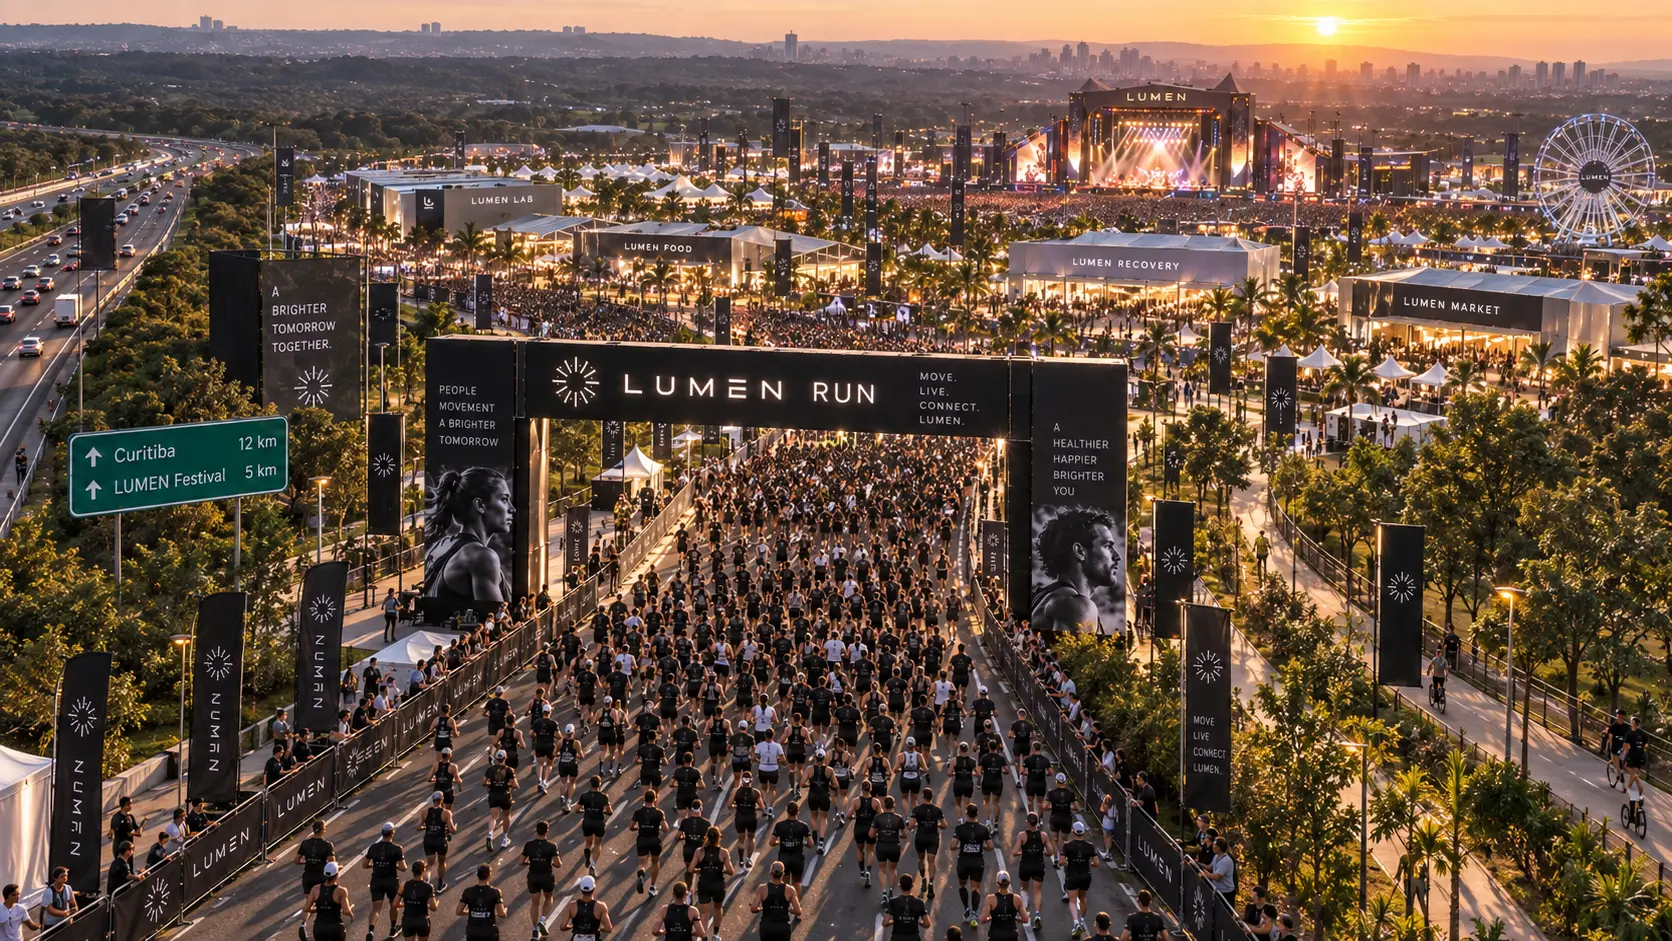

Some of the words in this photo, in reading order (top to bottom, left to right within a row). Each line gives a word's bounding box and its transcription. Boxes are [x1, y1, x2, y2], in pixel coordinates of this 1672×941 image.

[1126, 92, 1188, 103] LUMEN
[1580, 174, 1610, 182] LUMEN
[471, 196, 508, 205] LUMEN
[624, 242, 659, 252] LUMEN
[663, 243, 692, 253] FOOD
[1072, 258, 1112, 267] LUMEN
[1117, 259, 1180, 271] RECOVERY
[271, 285, 280, 297] A
[272, 302, 327, 316] BRIGHTER
[1403, 296, 1445, 309] LUMEN
[1451, 301, 1500, 315] MARKET
[271, 320, 336, 335] TOMORROW
[271, 338, 332, 353] TOGETHER.
[919, 372, 957, 382] MOVE.
[439, 384, 477, 396] PEOPLE
[624, 373, 782, 401] LUMEN
[813, 381, 875, 404] RUN
[919, 386, 949, 397] LIVE.
[439, 401, 495, 413] MOVEMENT
[919, 400, 980, 412] CONNECT.
[438, 418, 446, 428] A
[448, 418, 496, 430] BRIGHTER
[919, 415, 965, 426] LUMEN.
[1053, 422, 1061, 432] A
[439, 435, 499, 447] TOMORROW
[1053, 438, 1109, 450] HEALTHIER
[115, 444, 175, 462] Curitiba
[239, 437, 252, 450] 12
[258, 435, 276, 448] km
[1053, 454, 1097, 465] HAPPIER
[115, 475, 168, 494] LUMEN
[175, 468, 225, 487] Festival
[246, 465, 253, 478] 5
[258, 464, 276, 477] km
[1053, 470, 1104, 481] BRIGHTER
[1053, 486, 1075, 496] YOU
[1193, 715, 1215, 727] MOVE
[1193, 731, 1210, 742] LIVE
[1193, 763, 1222, 775] LUMEN.
[278, 776, 325, 818] LUMEN
[193, 827, 251, 879] LUMEN
[1137, 834, 1173, 884] LUMEN
